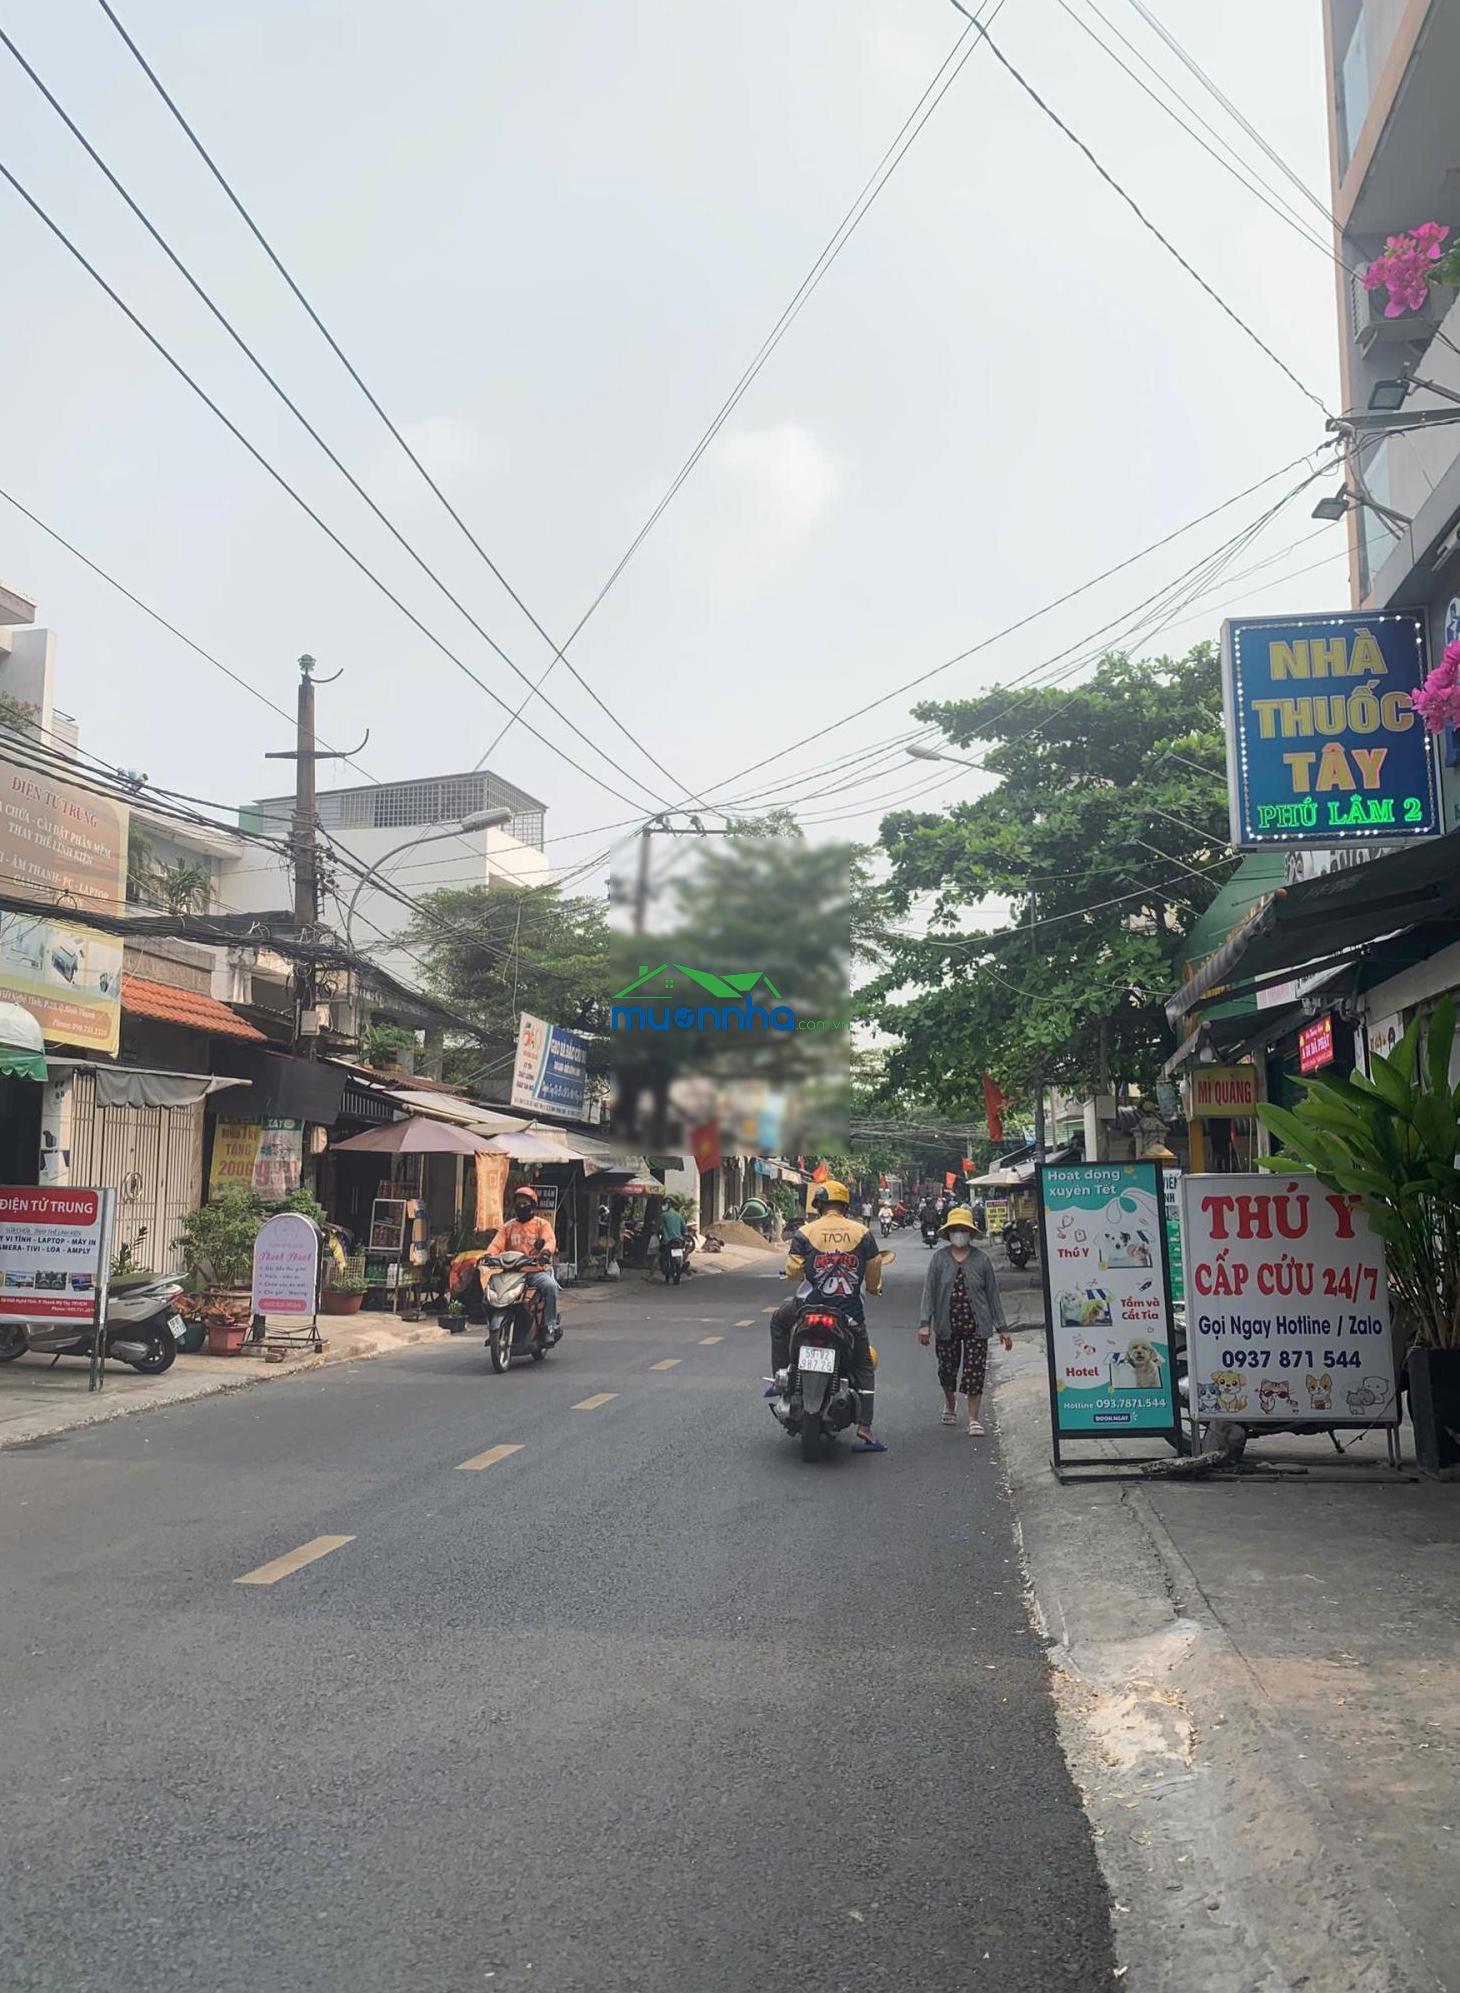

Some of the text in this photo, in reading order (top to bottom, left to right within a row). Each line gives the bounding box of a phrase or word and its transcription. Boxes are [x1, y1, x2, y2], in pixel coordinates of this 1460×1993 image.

[1269, 627, 1389, 681] NHÀ
[1251, 679, 1415, 739] THUỐC
[1283, 742, 1388, 793] TÂY
[1258, 793, 1423, 828] PHÚ LÂM 2
[31, 1197, 49, 1212] TỬ
[50, 1200, 93, 1214] TRUNG
[1201, 1182, 1362, 1239] THÚ Y
[67, 1247, 91, 1255] AMPLY
[1057, 1246, 1089, 1258] Thú Y
[1195, 1248, 1379, 1304] CẤP CỨU 24/7
[1120, 1296, 1160, 1308] Tắm và
[1198, 1316, 1226, 1340] Gọi
[1230, 1316, 1271, 1340] Ngay
[1276, 1316, 1331, 1335] Hotline
[1349, 1316, 1382, 1335] Zalo
[1222, 1351, 1362, 1368] 0937 871 544
[1065, 1367, 1100, 1377] Hotel
[1095, 1398, 1167, 1409] 093.7871.544
